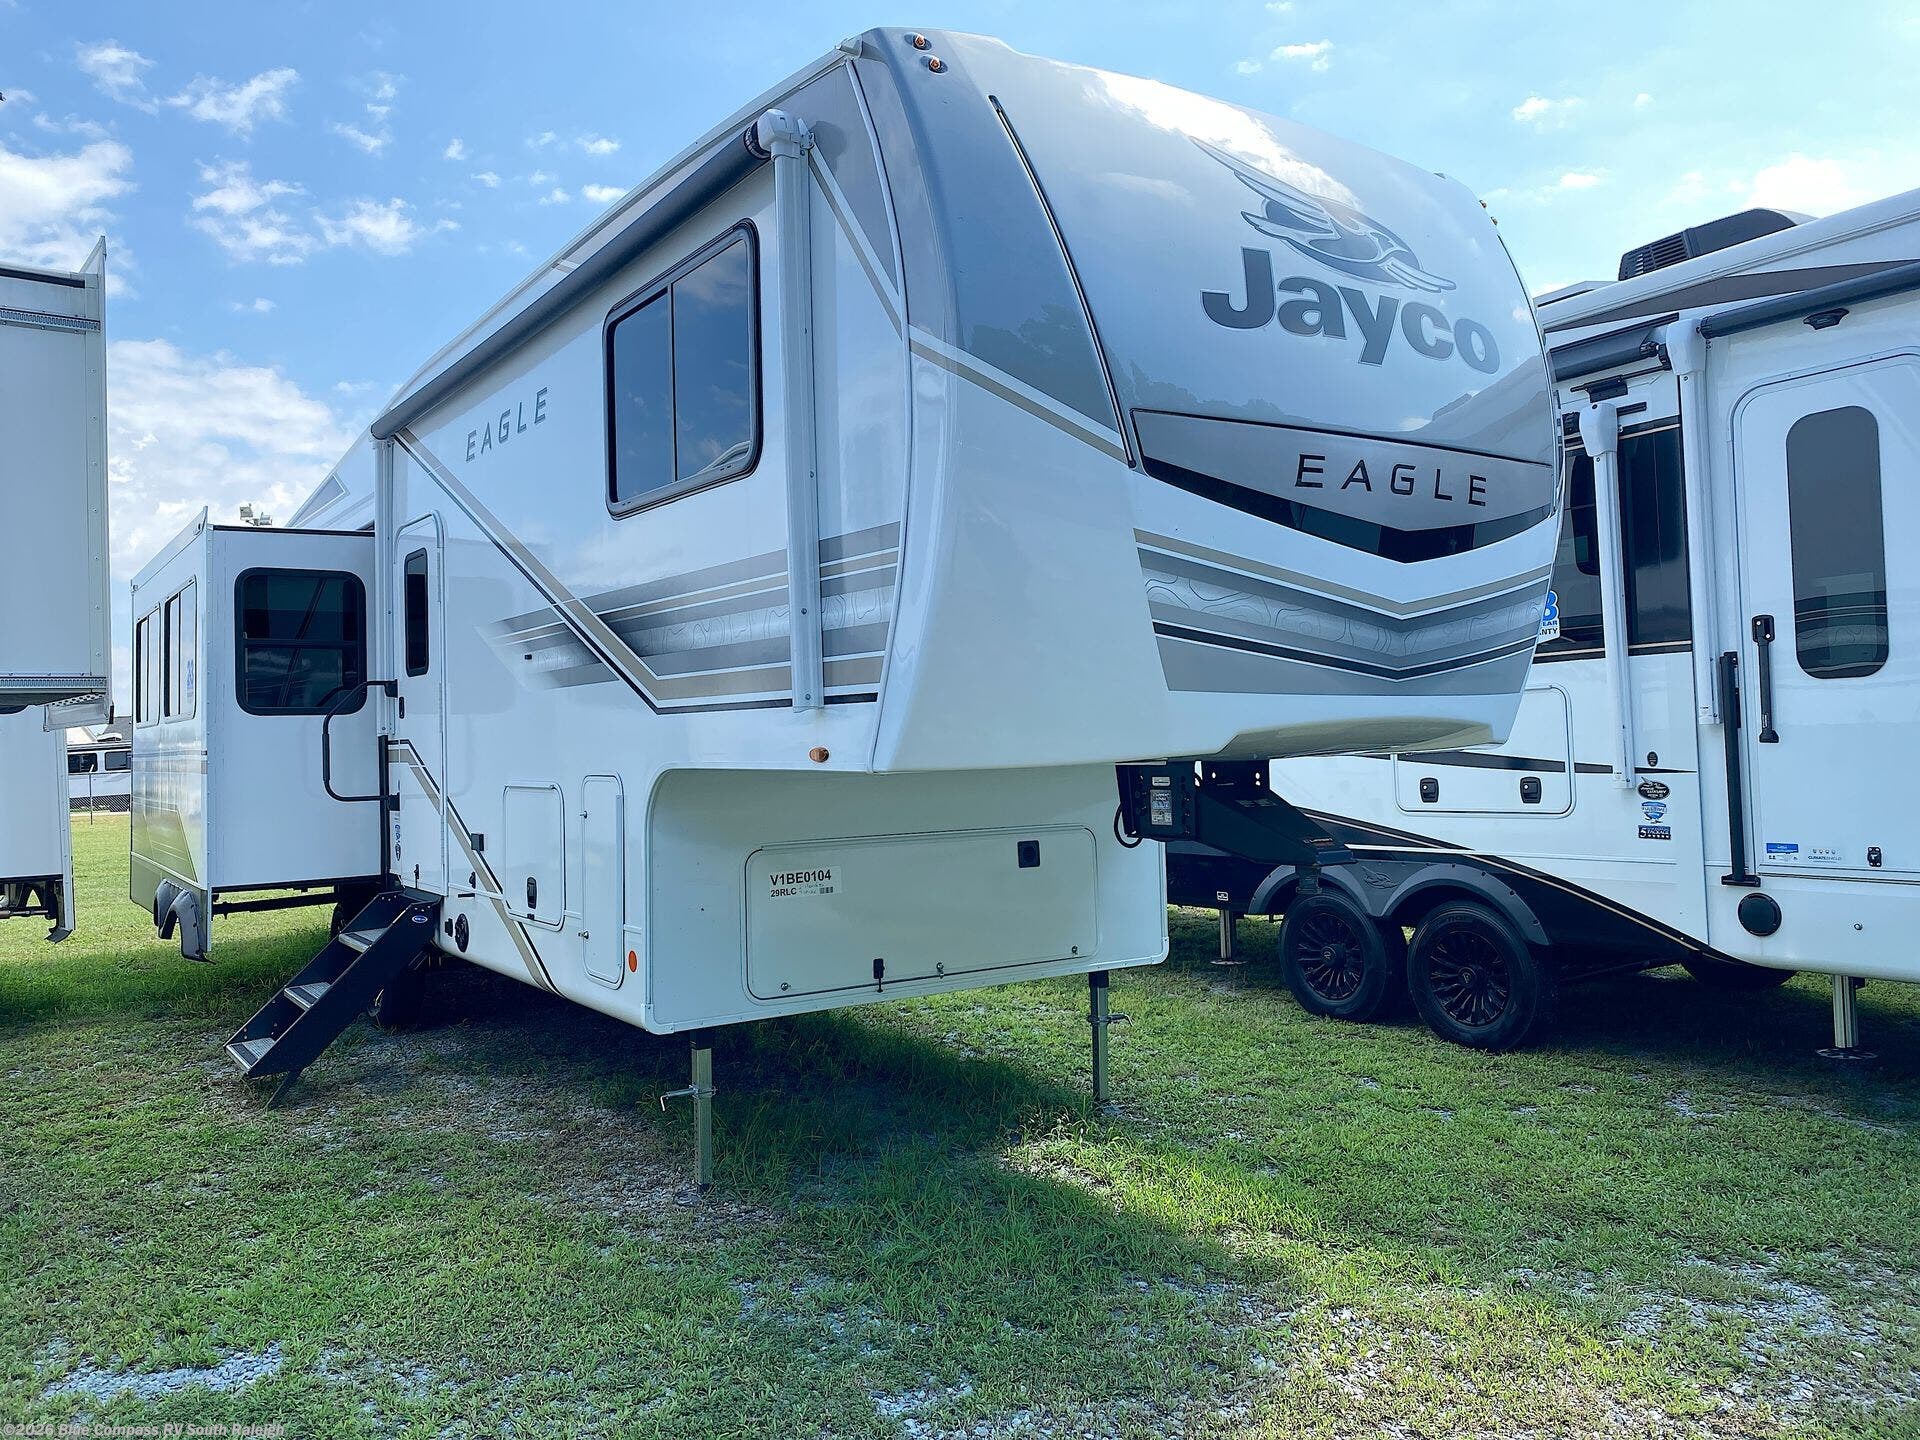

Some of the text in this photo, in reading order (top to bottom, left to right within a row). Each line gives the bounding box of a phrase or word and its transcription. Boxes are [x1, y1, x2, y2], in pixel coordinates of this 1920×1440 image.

[1200, 246, 1501, 375] Jayco
[465, 386, 548, 463] EAGLE
[1295, 453, 1487, 507] EAGLE
[770, 869, 832, 885] V1BE0104
[770, 887, 798, 898] 29RLC
